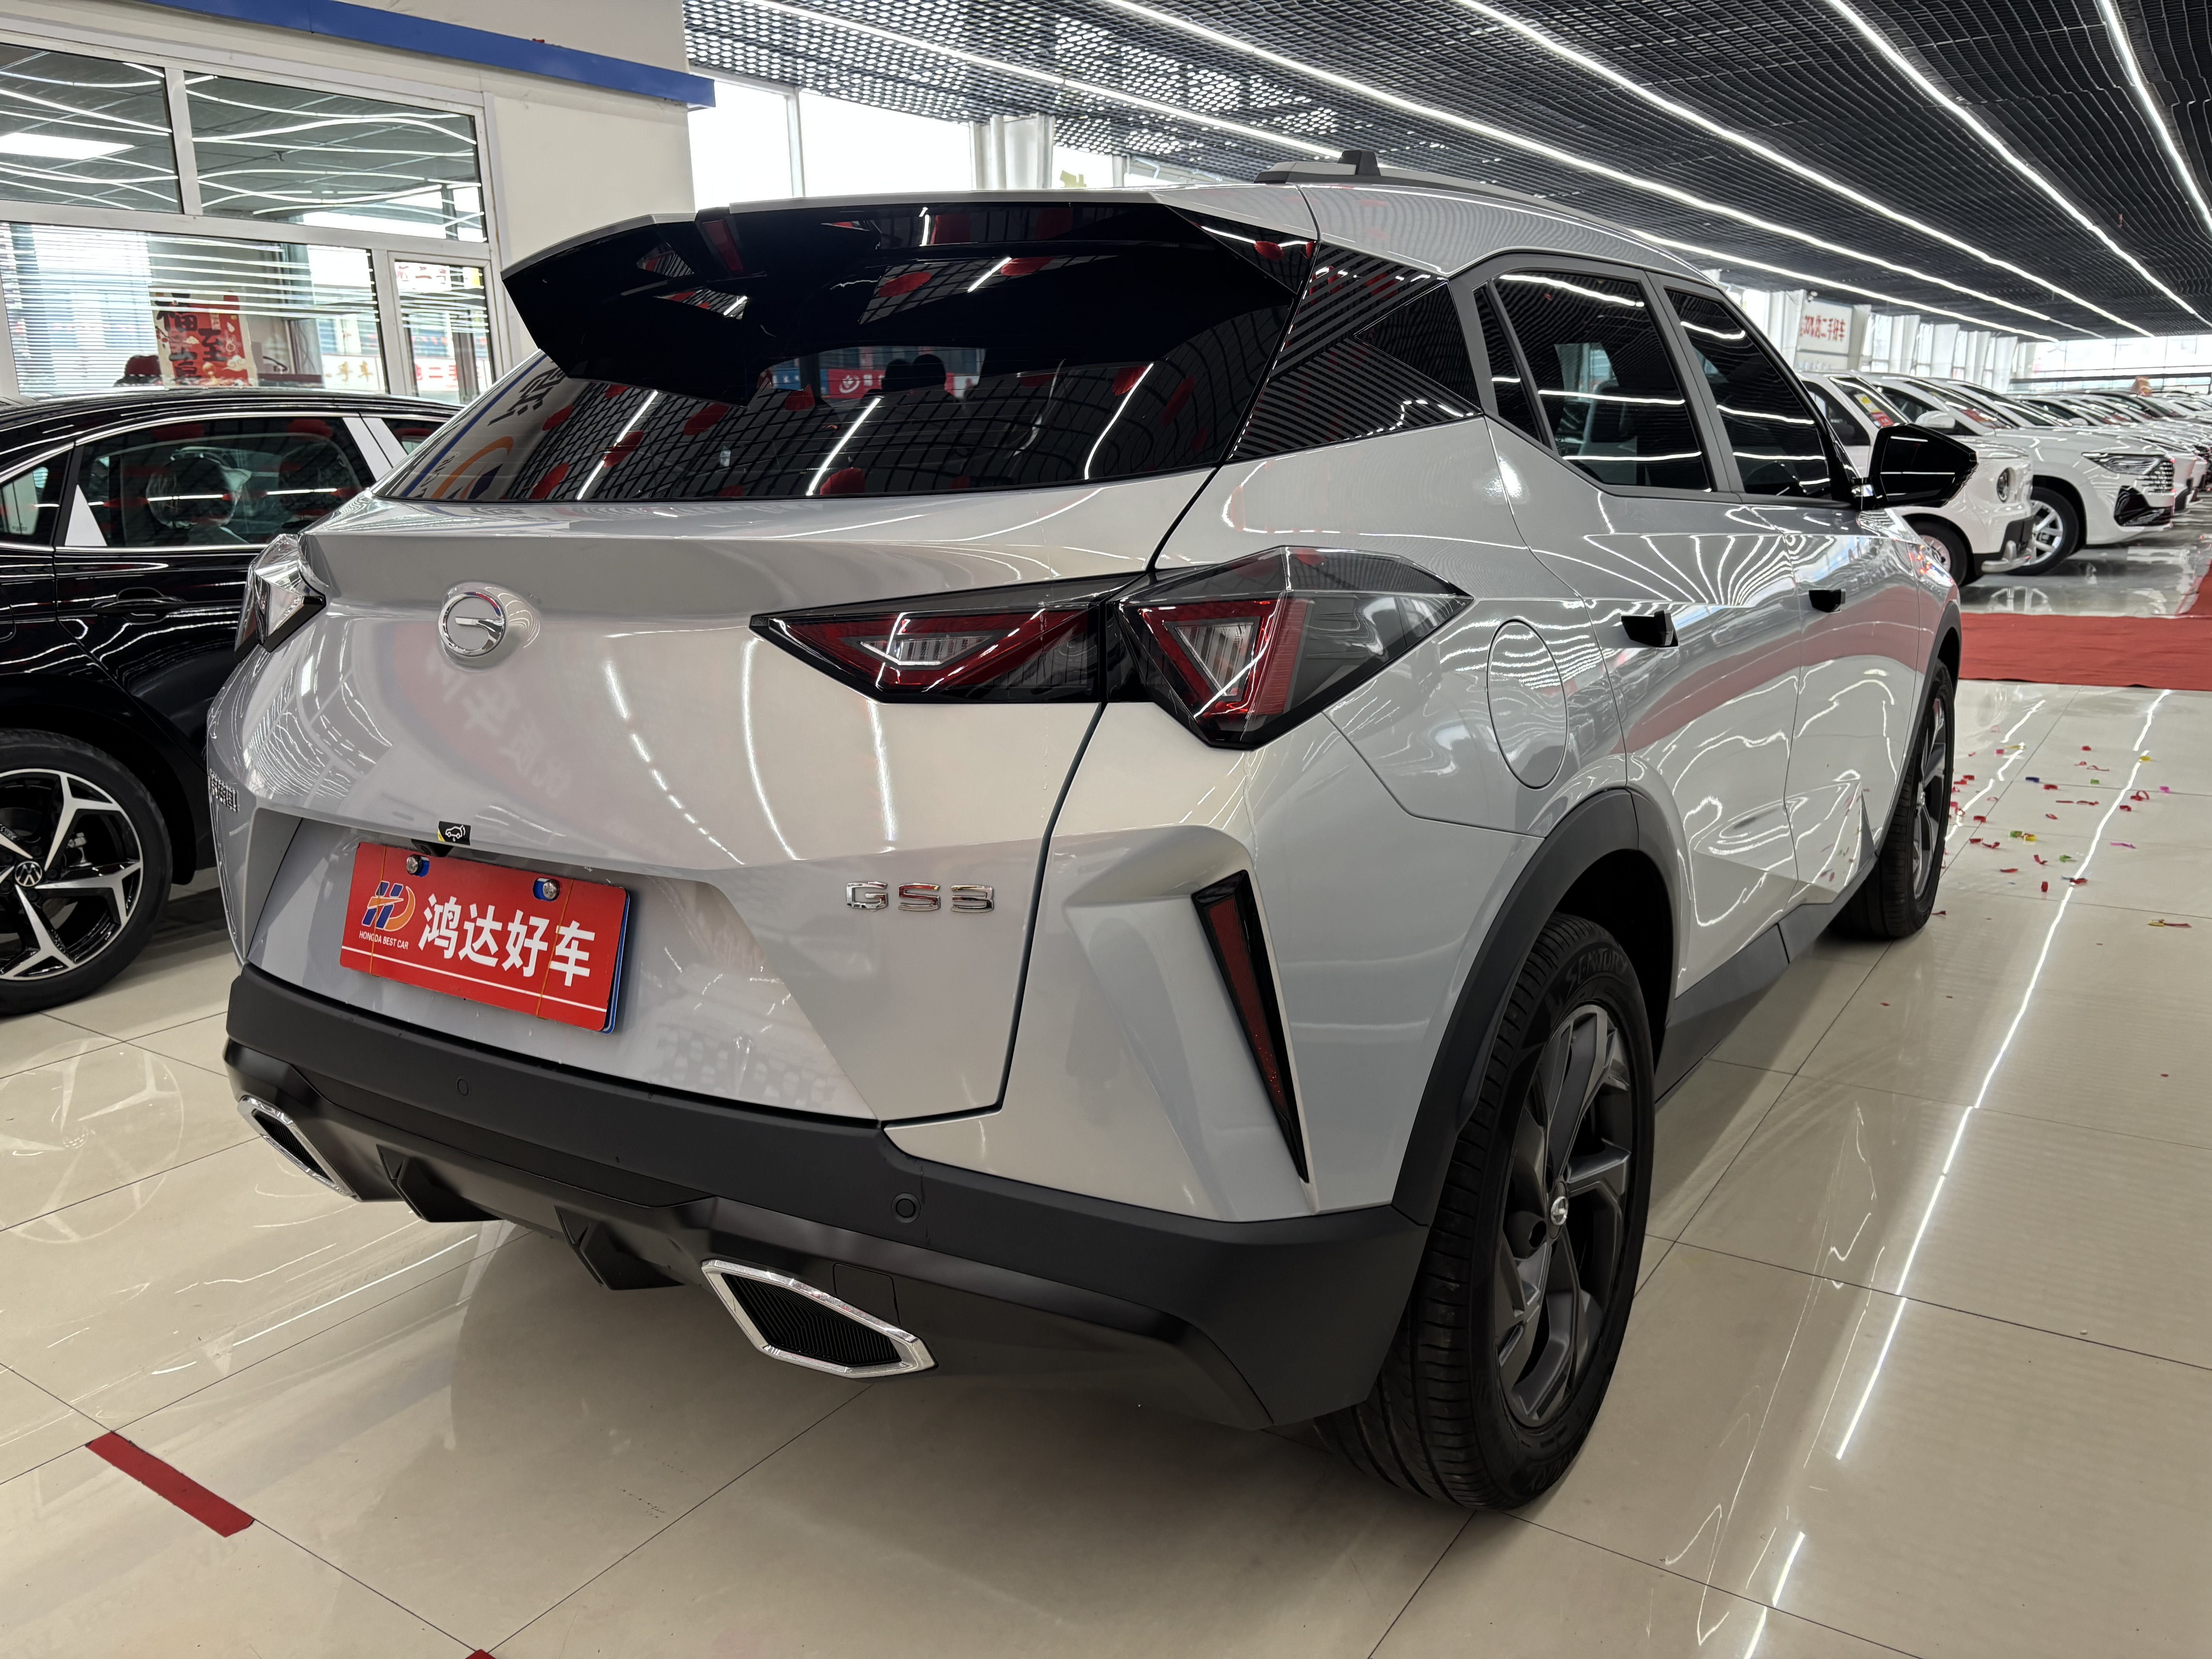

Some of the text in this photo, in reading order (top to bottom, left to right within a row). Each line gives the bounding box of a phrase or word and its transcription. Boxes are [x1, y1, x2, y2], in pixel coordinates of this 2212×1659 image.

[846, 881, 994, 913] GS3
[359, 930, 409, 950] HONGDA BEST CAR
[418, 893, 595, 987] 鸿达好车
